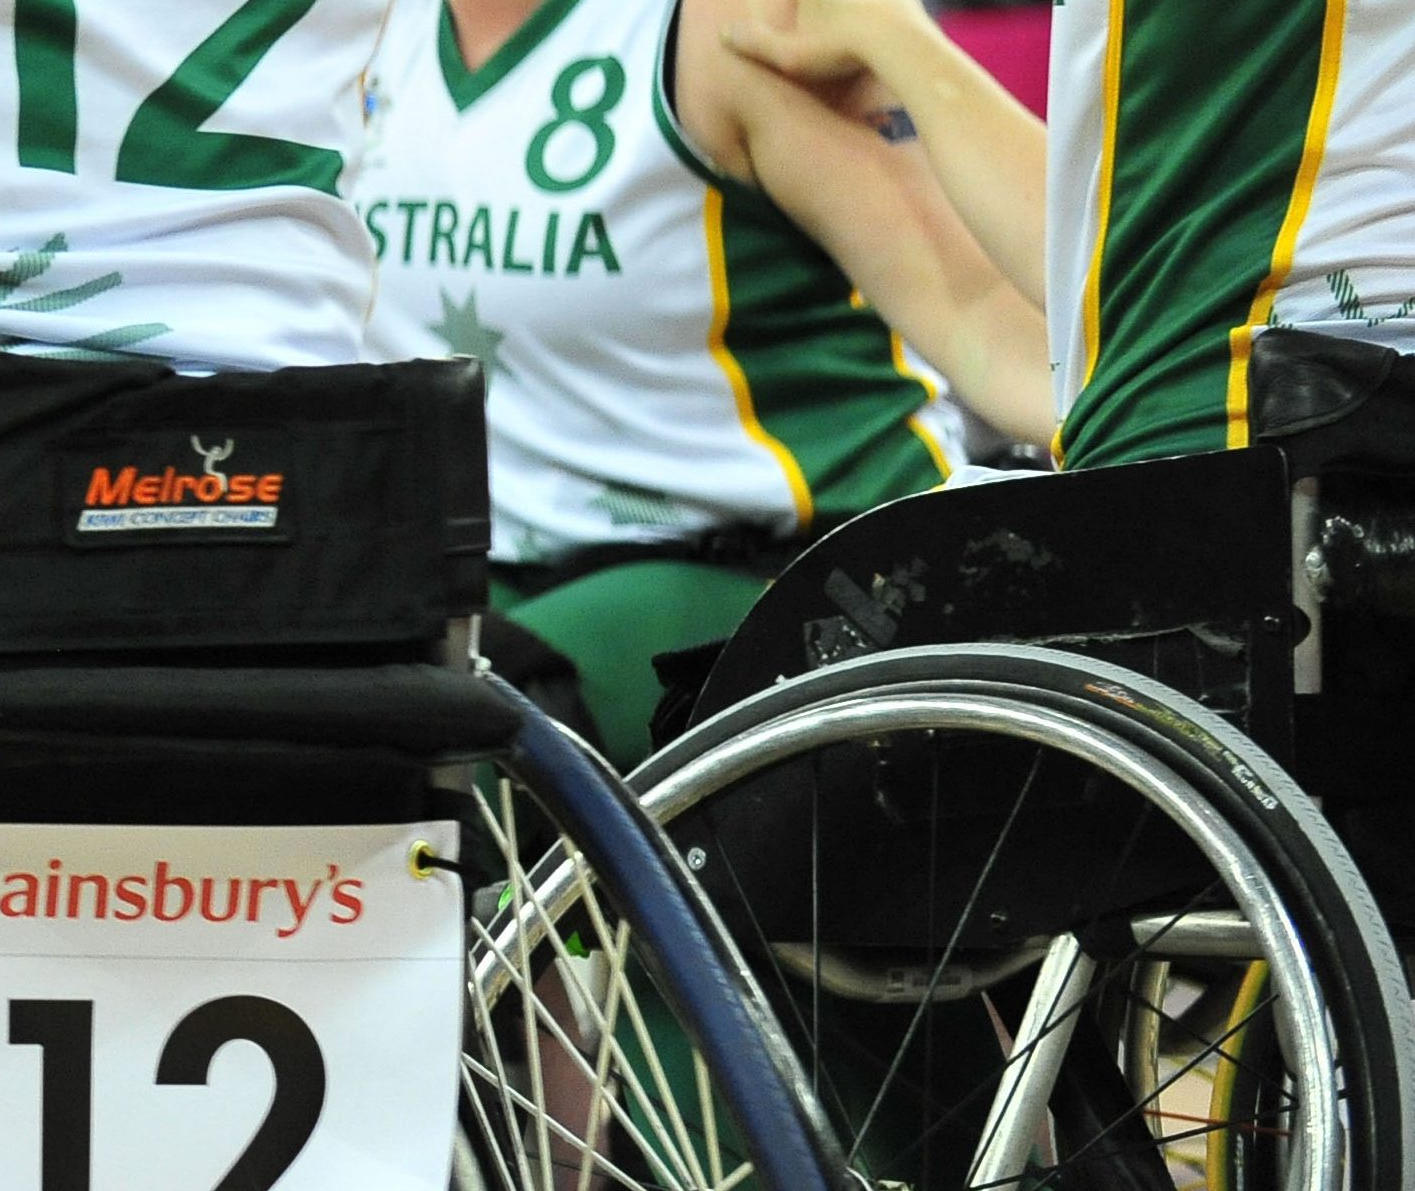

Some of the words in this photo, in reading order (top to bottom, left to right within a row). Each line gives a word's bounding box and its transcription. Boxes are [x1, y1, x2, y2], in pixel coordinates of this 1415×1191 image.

[525, 54, 626, 193] 8
[354, 200, 621, 275] STRALIA
[85, 465, 284, 506] Melrose
